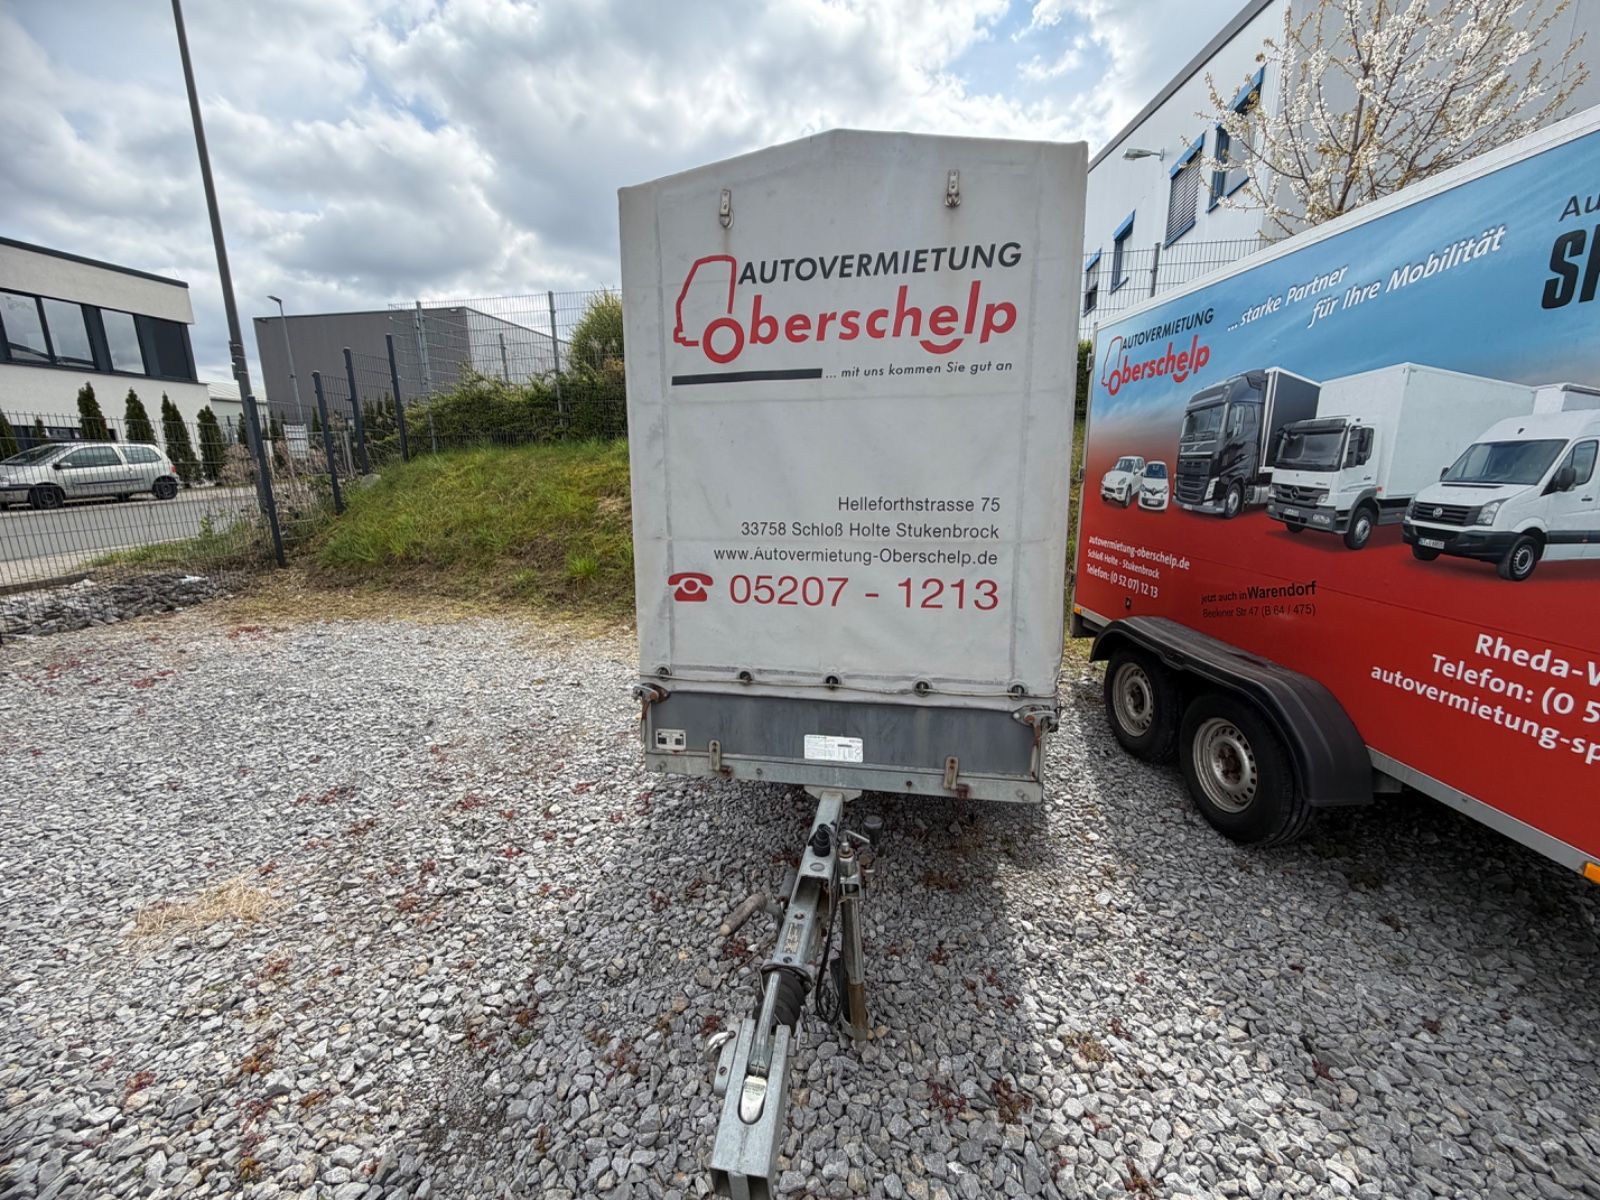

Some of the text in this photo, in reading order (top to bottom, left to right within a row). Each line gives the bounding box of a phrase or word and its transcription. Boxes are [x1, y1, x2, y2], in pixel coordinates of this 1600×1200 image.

[738, 242, 1022, 285] AUTOVERMIETUNG
[1307, 225, 1507, 329] für Ihre Mobilität
[1239, 293, 1282, 327] starke
[1285, 264, 1349, 306] Partner
[702, 280, 1017, 364] Oberschelp
[1122, 309, 1214, 350] AUTOVERMIETUNG
[841, 366, 860, 378] mit
[863, 367, 884, 377] uns
[888, 363, 941, 376] kommen
[946, 361, 965, 373] Sie
[970, 361, 992, 375] gut
[995, 362, 1012, 371] an
[1108, 334, 1210, 396] Oberschelp
[838, 496, 1000, 512] Helleforthstrasse 75
[741, 522, 999, 539] 33758 Schloß Holte Stukenbrock
[713, 547, 998, 566] www.Autovermietung-Oberschelp.de
[1089, 536, 1190, 570] autovermietung-oberschelp.de
[1105, 554, 1118, 566] Holte
[1122, 559, 1160, 579] Stukenbrock
[729, 575, 849, 607] 05207
[898, 577, 999, 610] 1213
[1086, 563, 1110, 580] Telefon:
[1119, 575, 1127, 587] 52
[1127, 578, 1140, 594] 07)
[1141, 582, 1149, 594] 12
[1150, 585, 1158, 598] 13
[1218, 592, 1237, 601] auch
[1247, 581, 1317, 599] Warendorf
[1248, 606, 1259, 616] 47
[1262, 604, 1272, 617] (B
[1274, 604, 1285, 615] 64
[1293, 603, 1317, 616] 475)
[1432, 653, 1534, 704] Telefon:
